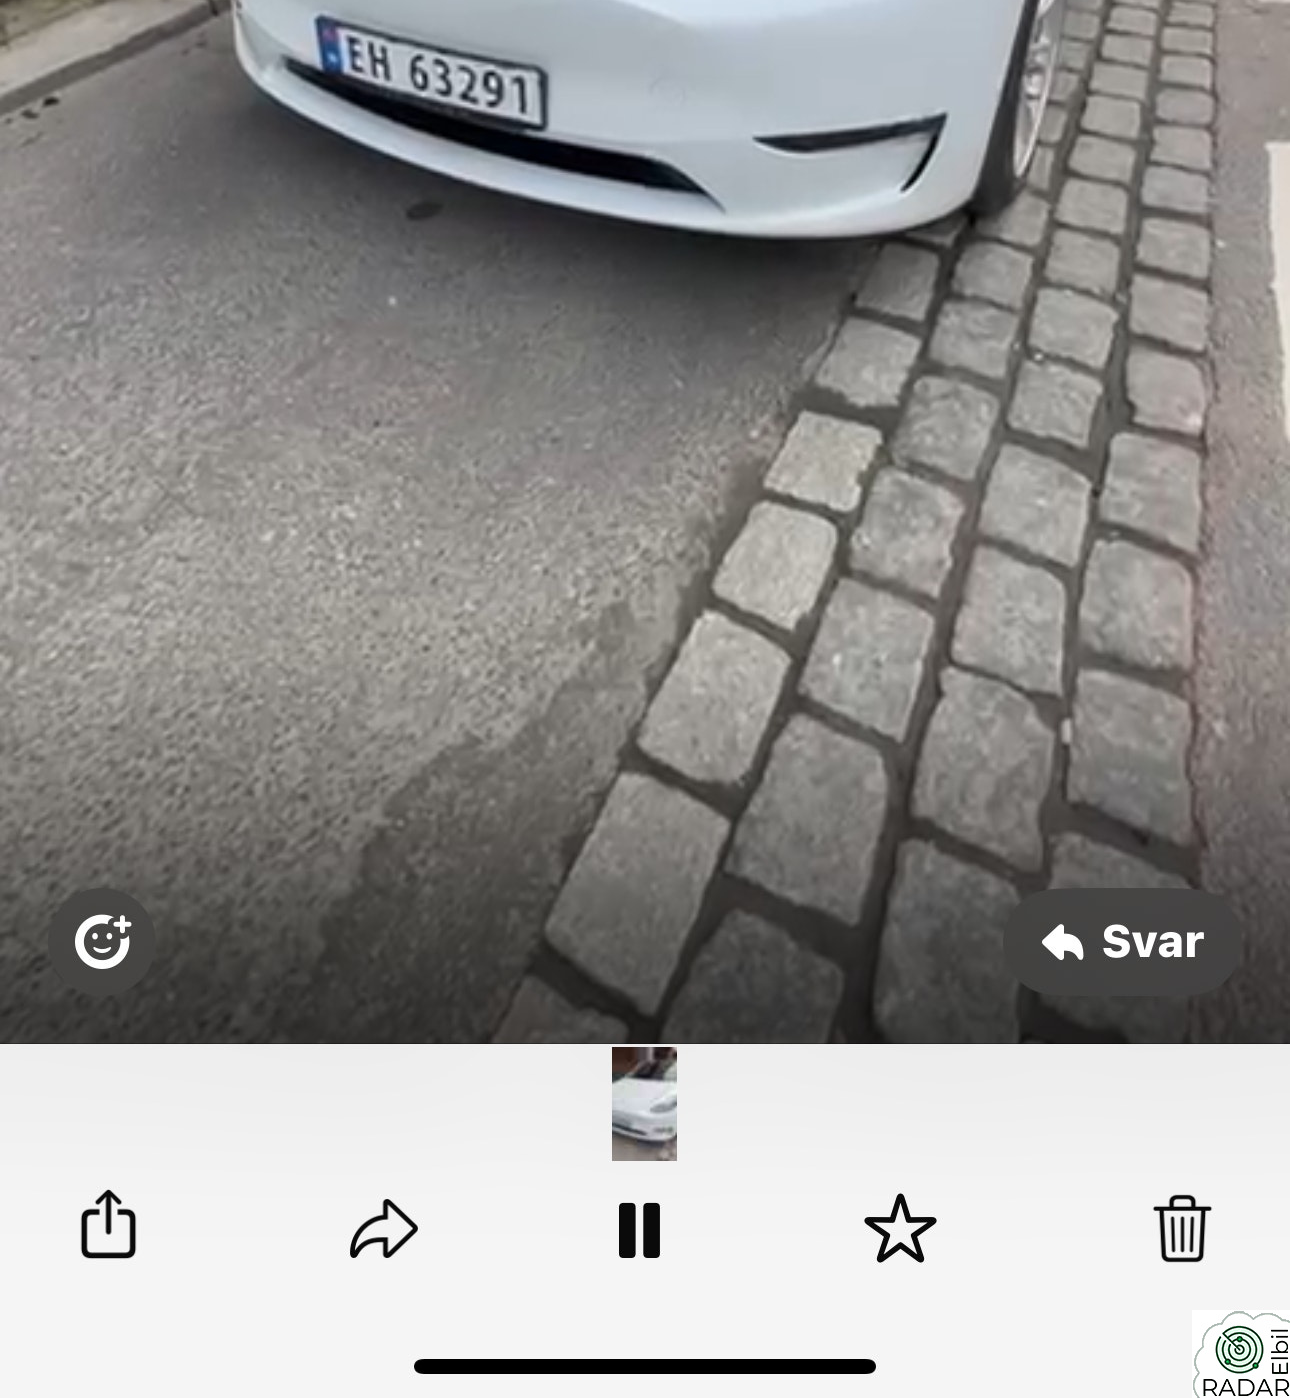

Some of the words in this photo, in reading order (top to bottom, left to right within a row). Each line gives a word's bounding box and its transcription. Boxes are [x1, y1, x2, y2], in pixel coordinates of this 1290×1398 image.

[346, 35, 392, 82] EH
[409, 53, 528, 114] 63291
[1102, 923, 1205, 959] Svar
